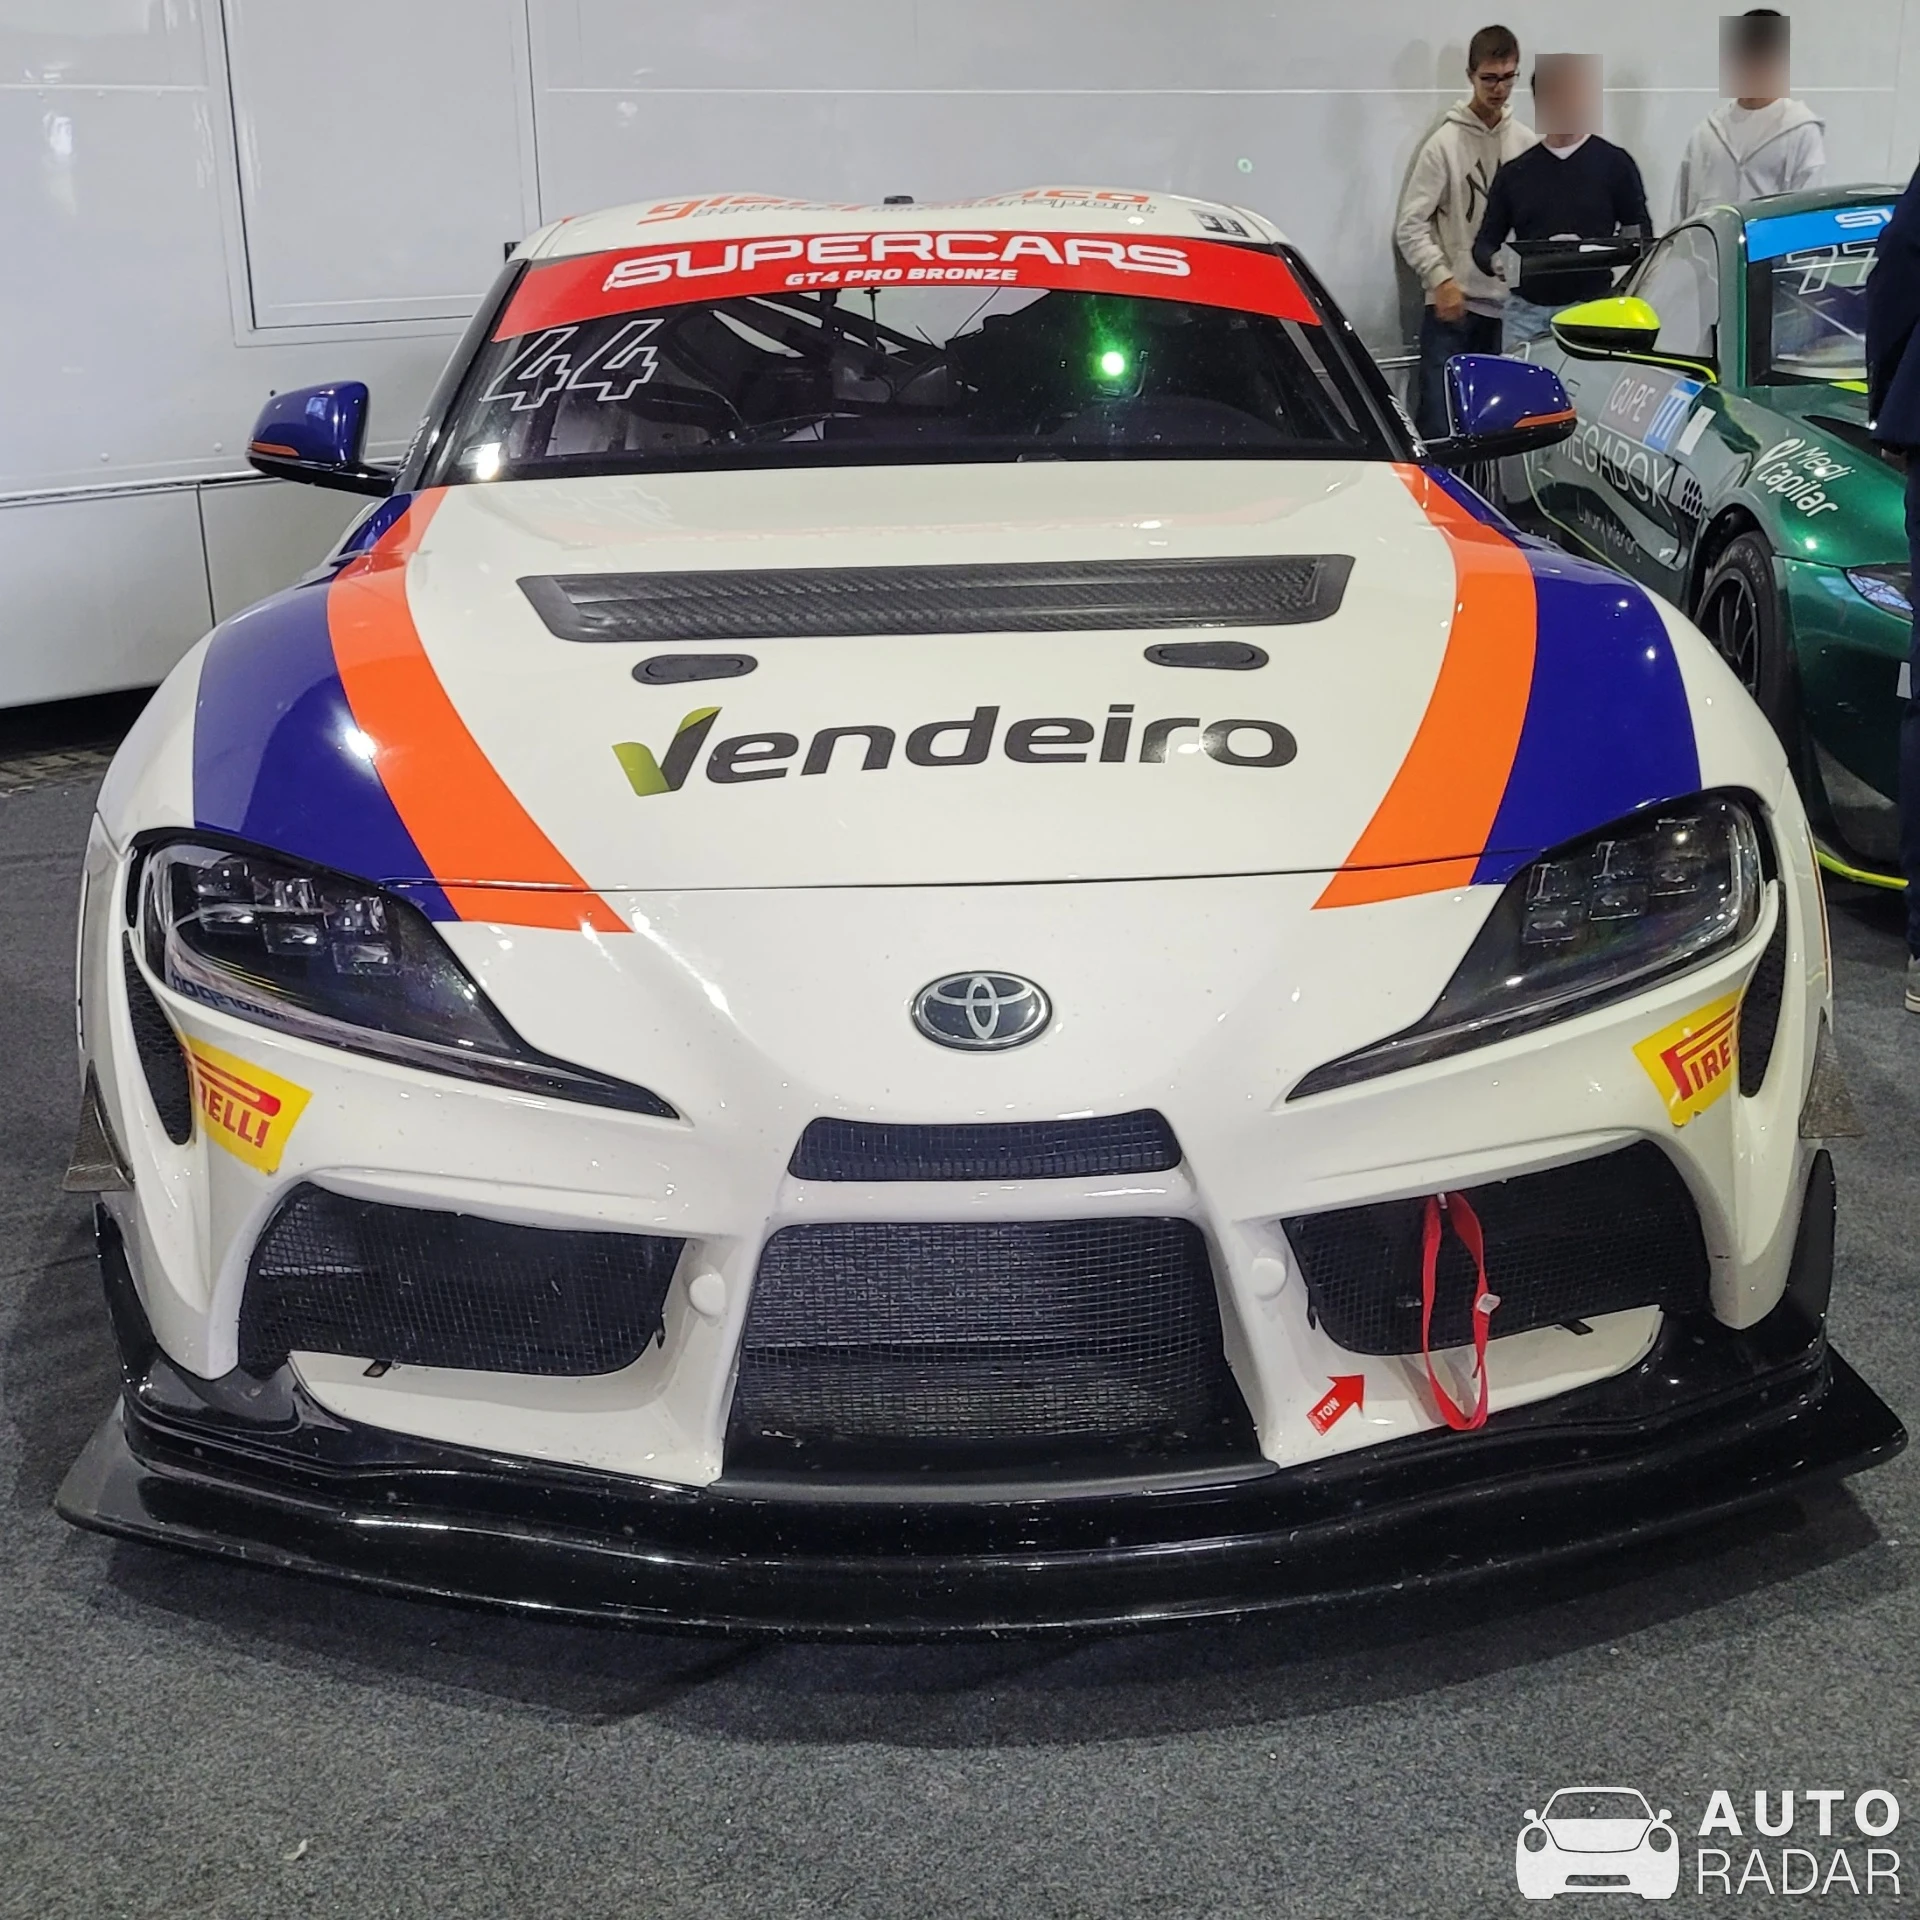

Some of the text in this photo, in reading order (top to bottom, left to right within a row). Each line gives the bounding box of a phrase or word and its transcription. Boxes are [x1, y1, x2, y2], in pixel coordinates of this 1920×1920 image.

[611, 233, 1191, 288] SUPERCARS
[785, 268, 1019, 286] GT4 PRO BRONZE
[479, 318, 665, 412] 44
[1757, 462, 1839, 518] capilar
[1789, 446, 1857, 482] Medi
[611, 705, 1298, 797] Vendeiro
[1659, 1003, 1736, 1102] PIRE
[1316, 1396, 1341, 1421] TOW
